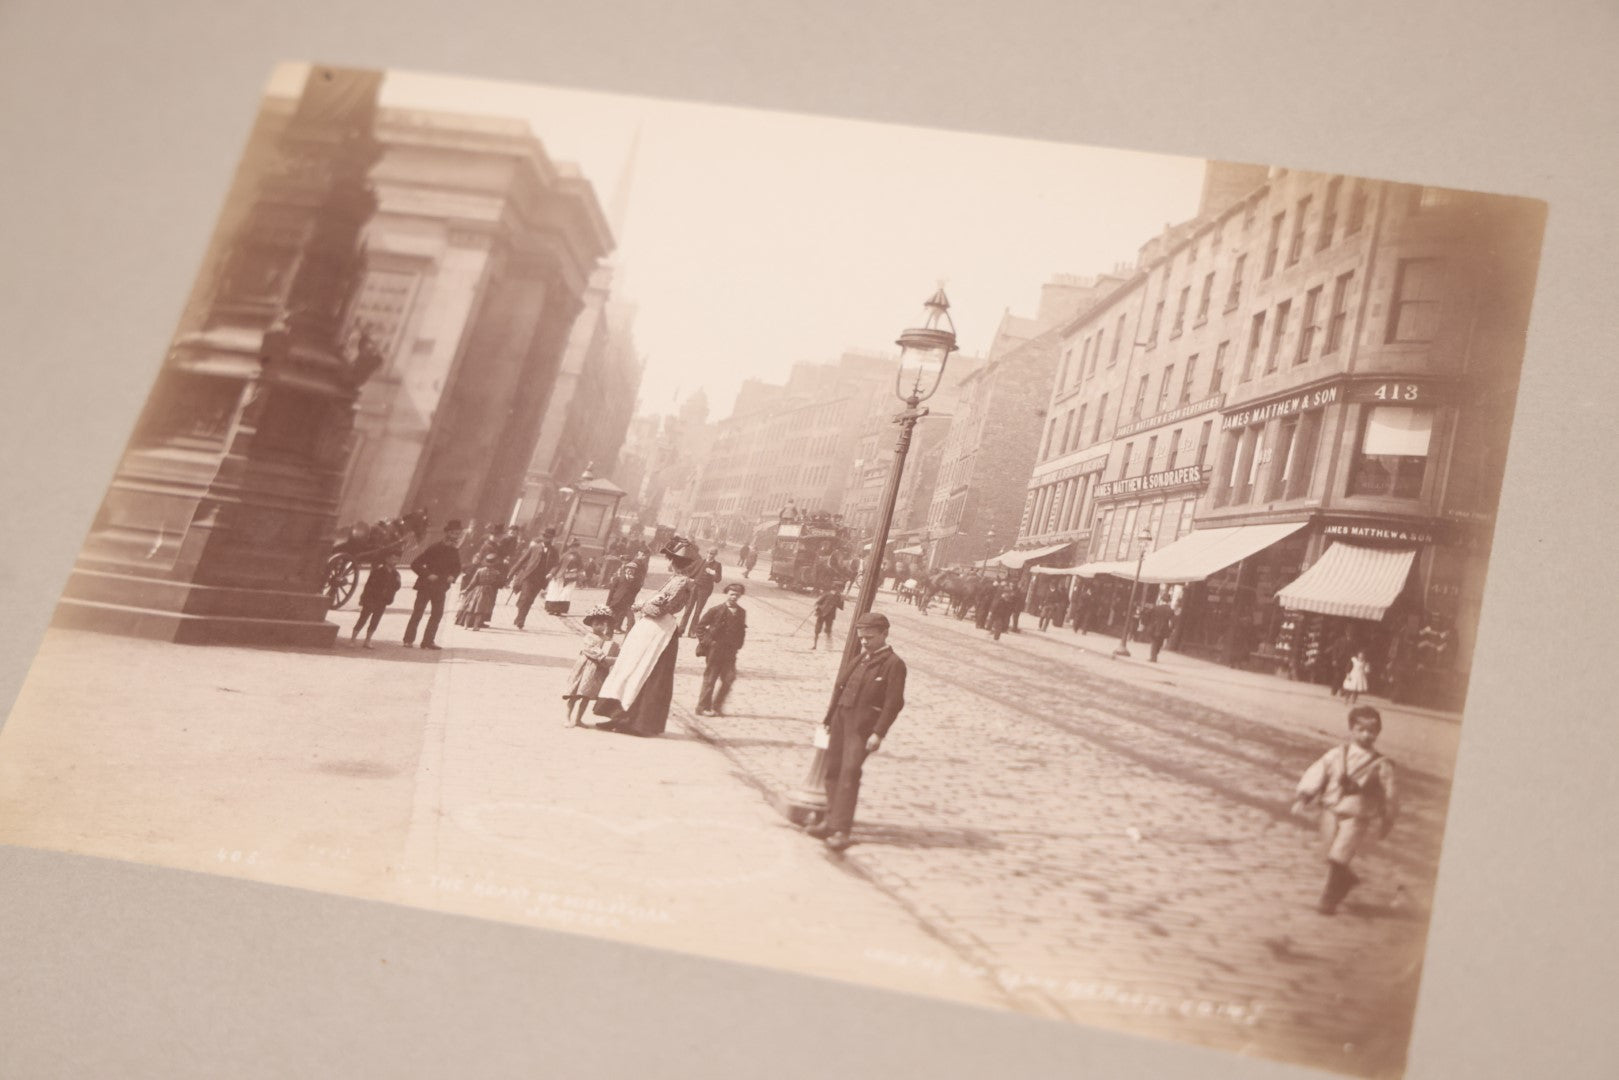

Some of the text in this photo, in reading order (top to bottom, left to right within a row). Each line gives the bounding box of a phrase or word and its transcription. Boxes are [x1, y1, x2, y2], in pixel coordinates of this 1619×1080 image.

[1374, 383, 1419, 401] 413
[1222, 386, 1338, 430] JAMES MATTHEW & SON
[1112, 476, 1143, 496] MATTHEW
[1143, 476, 1150, 490] &
[1324, 524, 1433, 543] JAMES MATTHEW & SON
